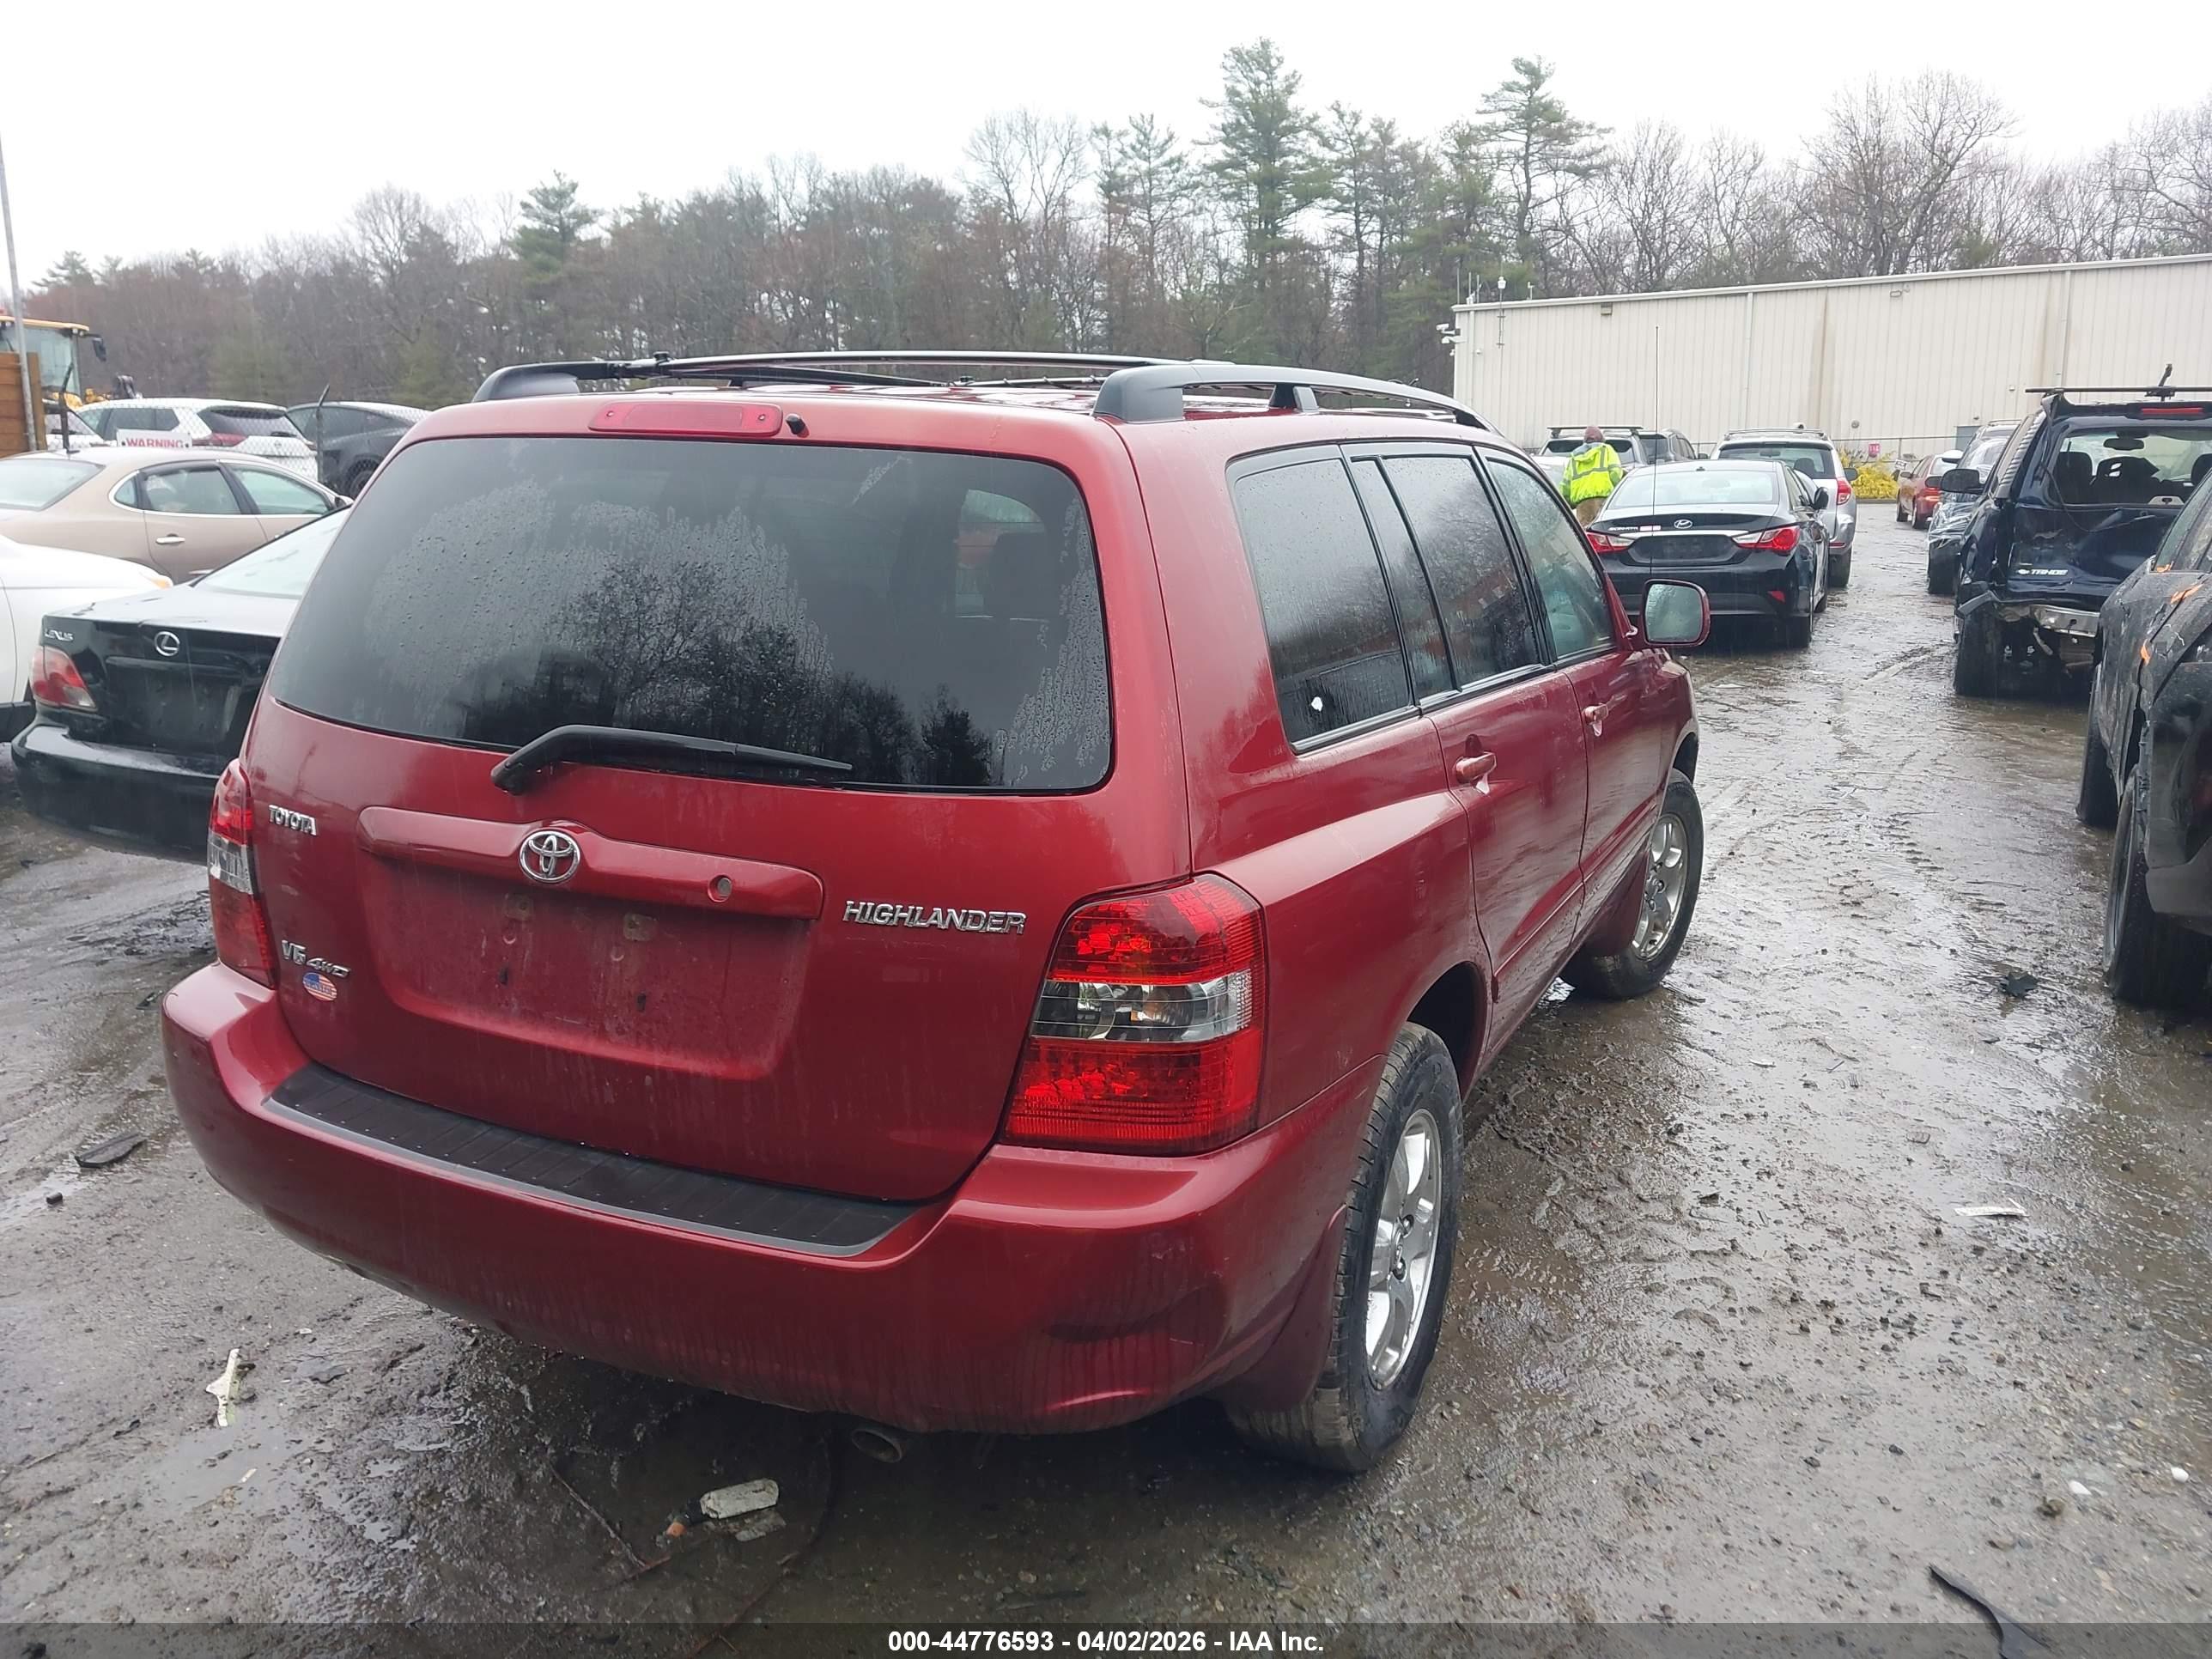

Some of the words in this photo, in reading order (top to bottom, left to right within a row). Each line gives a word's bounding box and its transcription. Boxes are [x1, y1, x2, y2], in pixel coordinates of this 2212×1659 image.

[125, 437, 184, 448] WARNING
[44, 628, 74, 641] LEXUS
[268, 804, 317, 836] TOYOTA
[842, 900, 1027, 935] HIGHLANDER
[281, 939, 307, 965] V6
